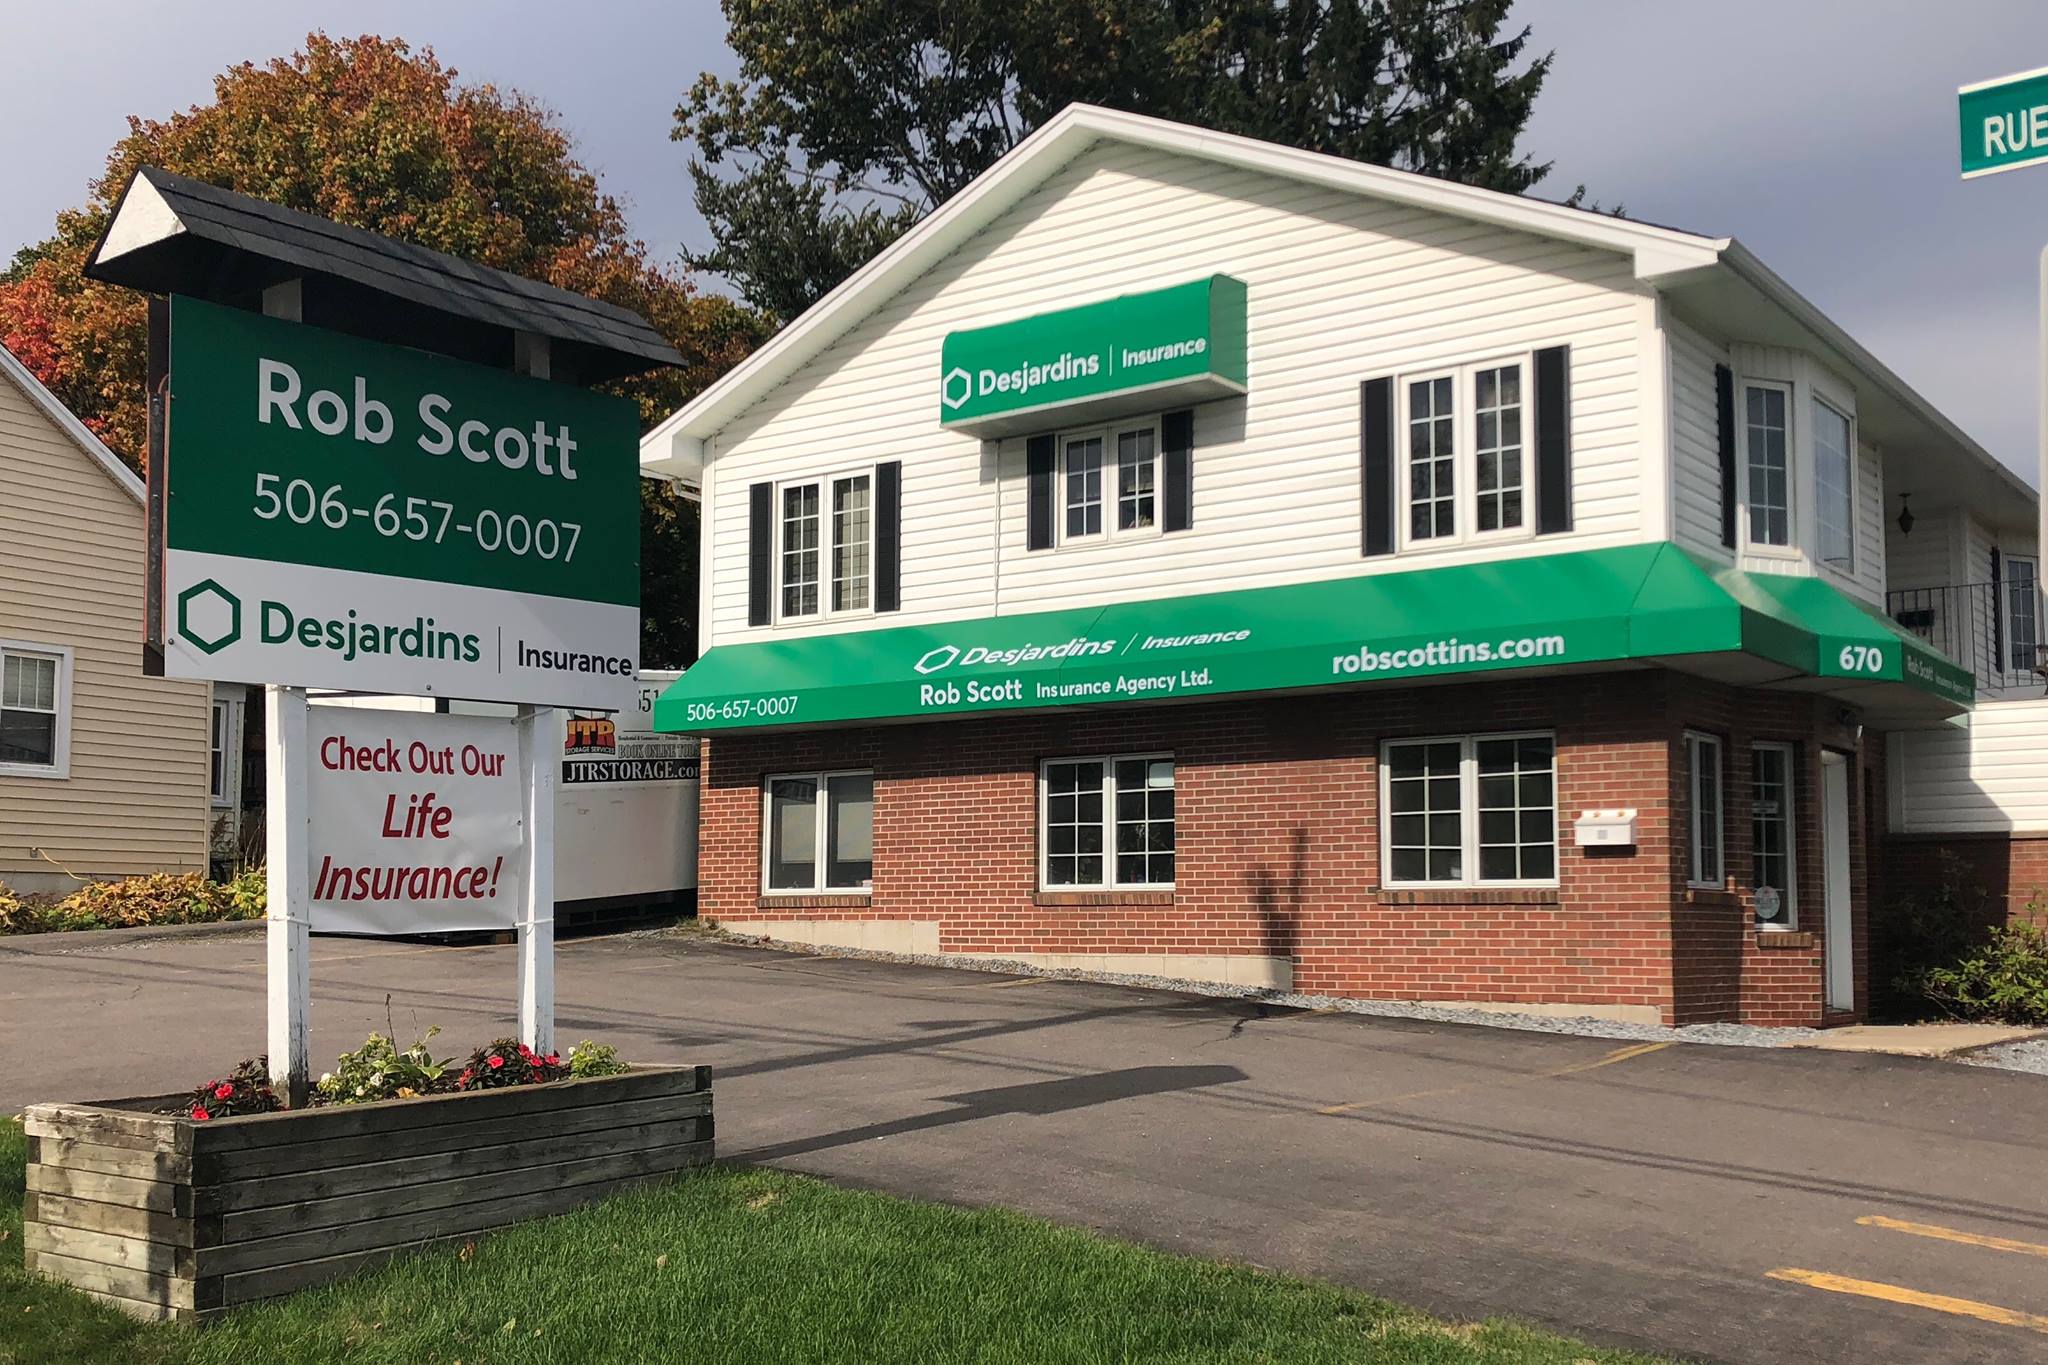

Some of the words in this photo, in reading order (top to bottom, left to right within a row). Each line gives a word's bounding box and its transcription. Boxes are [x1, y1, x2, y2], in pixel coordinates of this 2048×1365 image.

[1984, 104, 2048, 157] RUE
[979, 352, 1100, 396] Desjardins
[1122, 337, 1207, 368] Insurance
[257, 357, 395, 444] Rob
[416, 393, 579, 480] Scott
[252, 472, 582, 563] 506-657-0007
[260, 600, 481, 663] Desjardins
[518, 639, 633, 677] Insurance
[959, 637, 1117, 666] Desjardins
[1140, 629, 1251, 650] Insurance
[1332, 635, 1565, 674] robscottins.com
[1839, 645, 1883, 672] 670
[920, 681, 961, 706] Rob
[966, 679, 1023, 703] Scott
[1036, 681, 1111, 698] Insurance
[1115, 675, 1176, 695] Agency
[1181, 668, 1214, 688] Ltd.
[686, 696, 798, 721] 506-657-0007
[565, 719, 616, 749] JTR
[618, 744, 644, 759] BOOK
[320, 735, 401, 773] Check
[408, 740, 453, 776] Out
[461, 744, 506, 777] Our
[567, 761, 700, 781] JTRSTORAGE.co
[381, 792, 453, 839] Life
[313, 855, 504, 902] Insurance!
